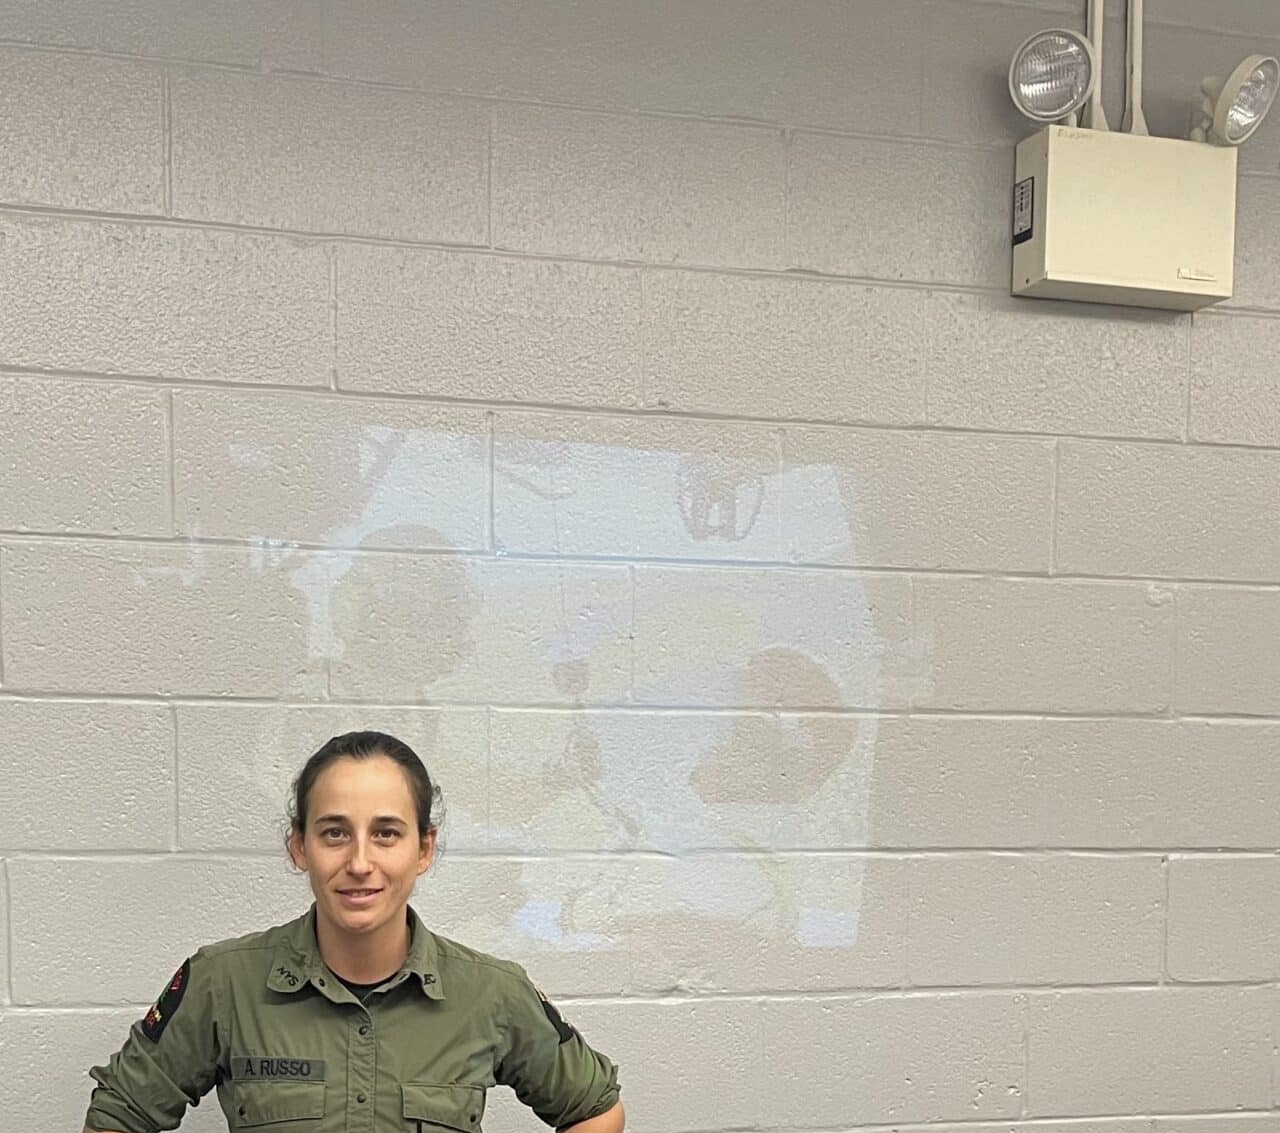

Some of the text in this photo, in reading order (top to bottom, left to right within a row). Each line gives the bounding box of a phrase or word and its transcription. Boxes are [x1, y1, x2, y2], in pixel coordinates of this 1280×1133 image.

[276, 966, 299, 987] NYS
[423, 973, 437, 985] EC
[260, 1059, 311, 1077] RUSSO
